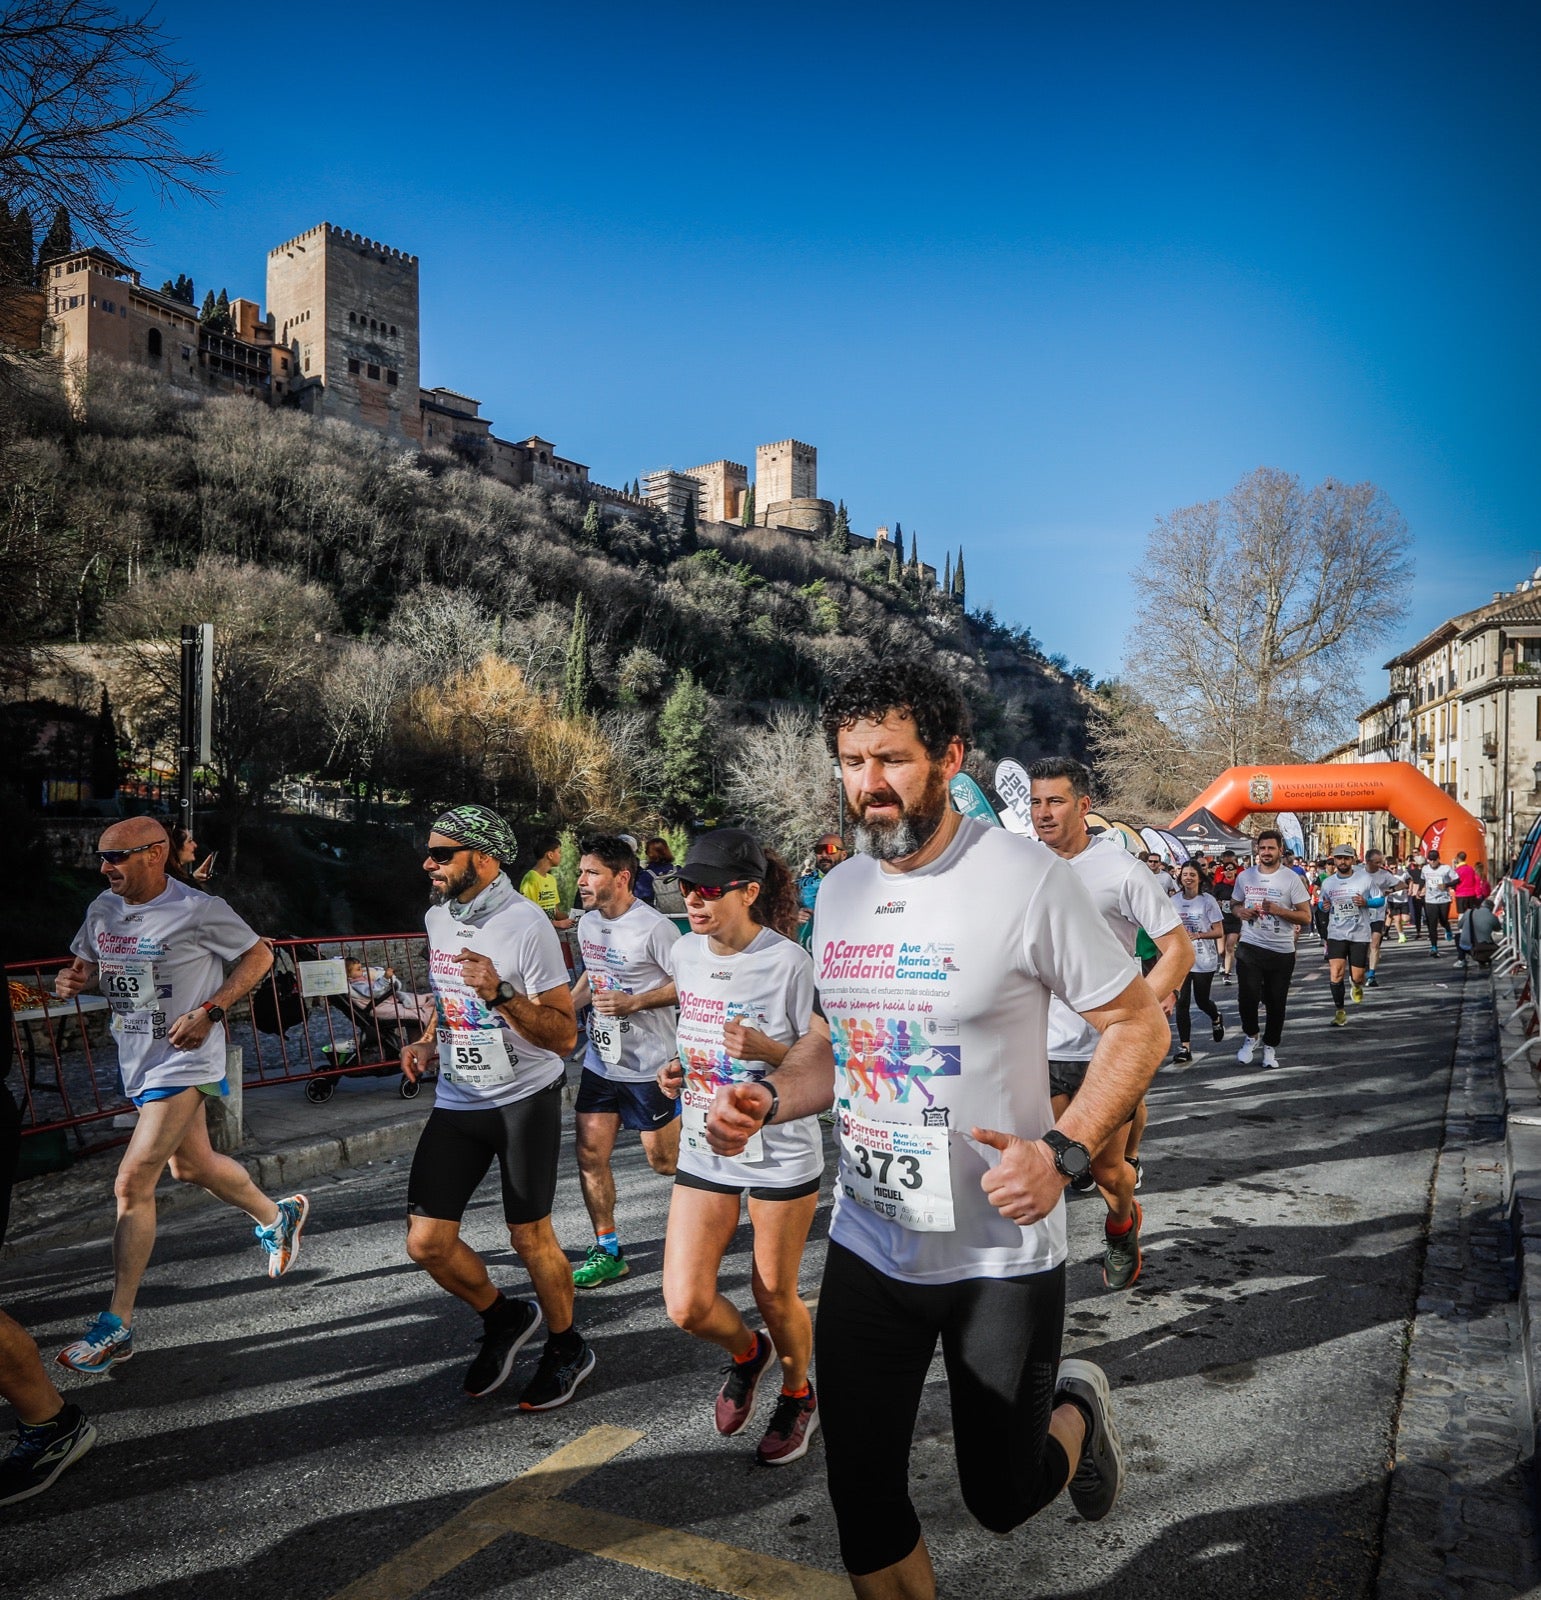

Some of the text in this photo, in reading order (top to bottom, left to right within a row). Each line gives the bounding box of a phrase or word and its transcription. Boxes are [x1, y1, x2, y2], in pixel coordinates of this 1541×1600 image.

[1340, 789, 1375, 797] Deportes
[874, 902, 905, 914] Altium
[105, 933, 138, 944] Carrera
[103, 943, 137, 954] Solidaria
[900, 942, 921, 953] Ave
[434, 949, 457, 962] Carre
[820, 941, 834, 979] 9
[834, 940, 894, 959] Carrera
[898, 955, 930, 967] María
[827, 959, 895, 979] Solidaria
[895, 968, 947, 981] Granada
[107, 976, 139, 992] 163
[687, 992, 724, 1011] Carrera
[727, 1001, 743, 1010] Ave
[682, 1006, 725, 1025] Solidaria
[440, 1030, 469, 1042] 9 Carrera
[457, 1047, 483, 1064] 55
[684, 1090, 692, 1105] 9
[843, 1114, 888, 1139] 9 Carrera
[851, 1130, 892, 1151] Solidaria
[893, 1131, 909, 1139] Ave
[893, 1146, 932, 1156] Granada
[854, 1145, 922, 1190] 373
[874, 1185, 904, 1201] MIGUEL
